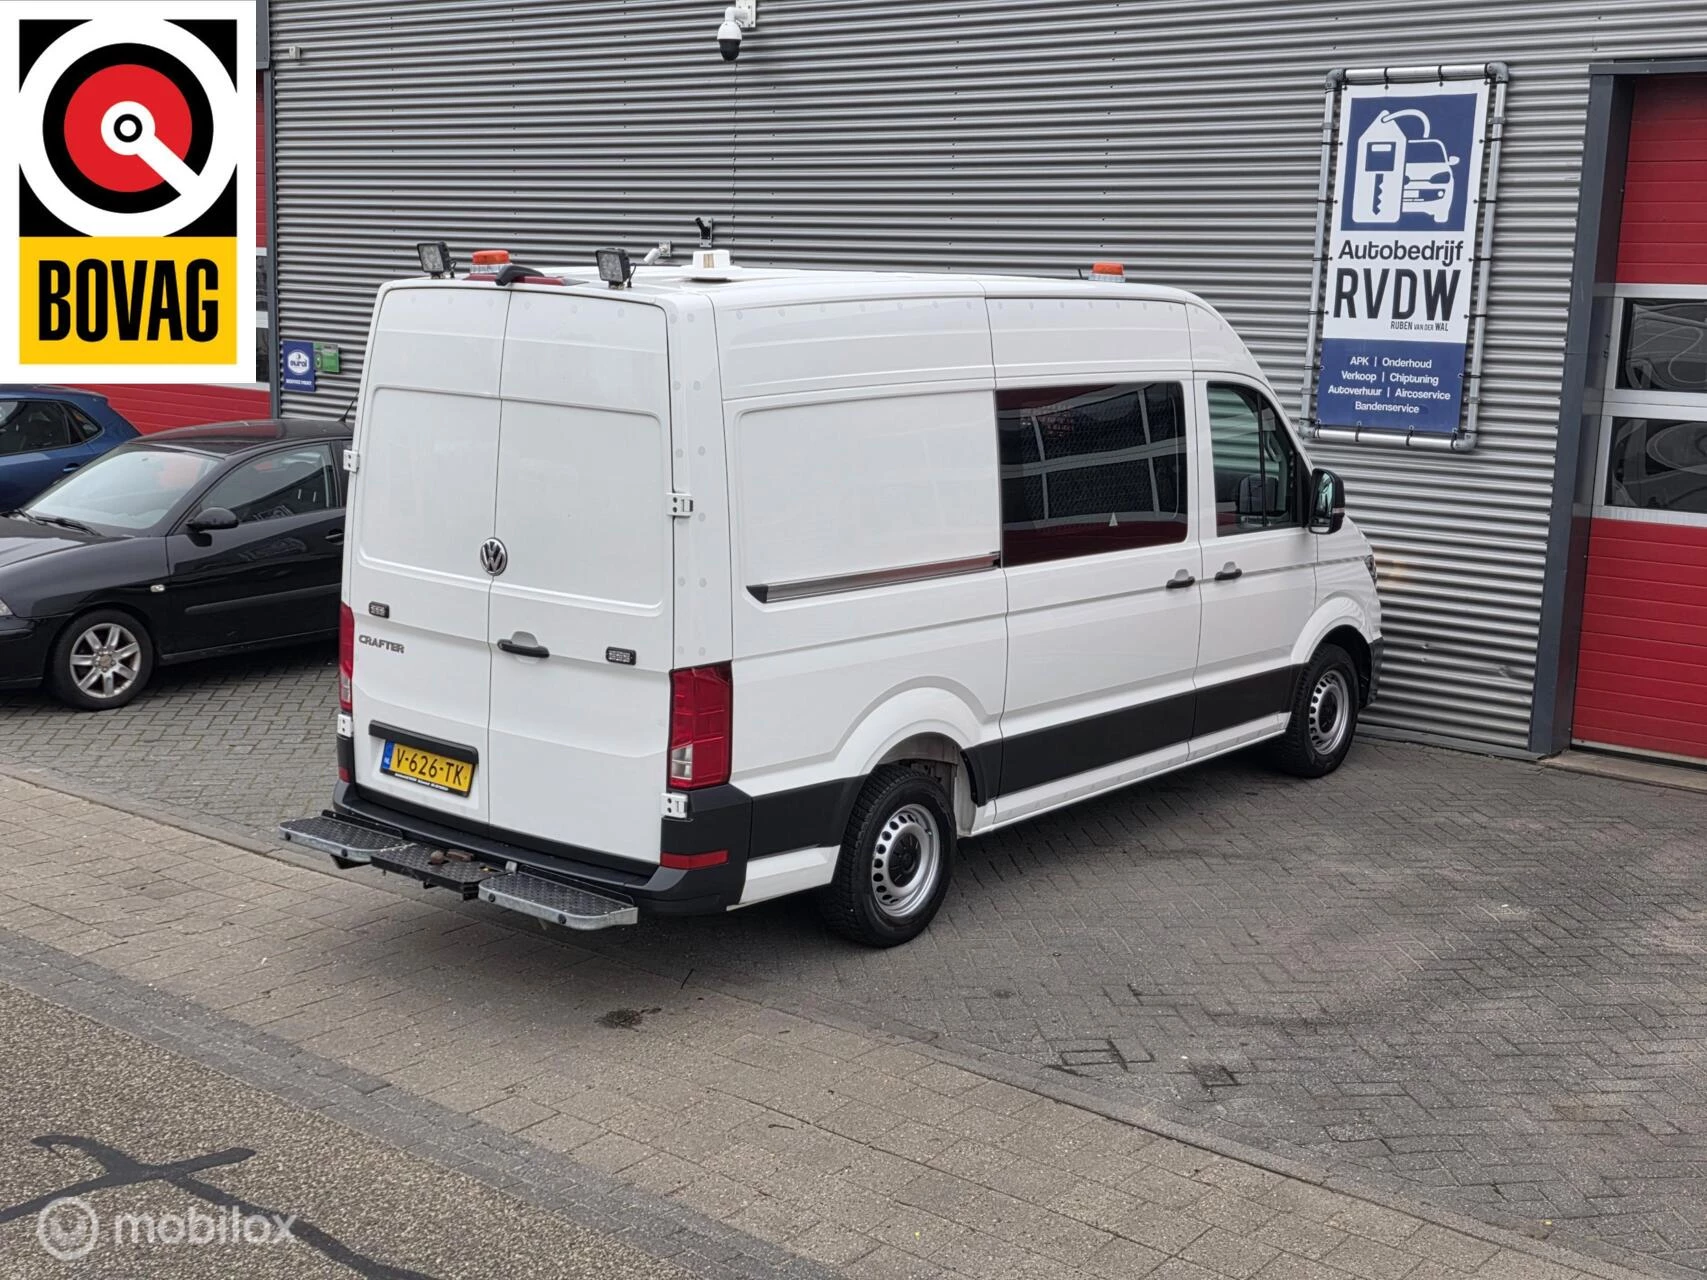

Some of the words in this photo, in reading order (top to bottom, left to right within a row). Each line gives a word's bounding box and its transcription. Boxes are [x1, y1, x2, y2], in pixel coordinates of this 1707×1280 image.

[1338, 240, 1464, 267] Autobedrijf
[1333, 267, 1462, 321] RVDW
[1390, 321, 1413, 330] RUBEN
[1434, 322, 1449, 331] WAL
[1350, 356, 1369, 366] APK
[1382, 357, 1432, 369] Onderhoud
[1341, 370, 1377, 383] Verkoop
[1389, 372, 1440, 387] Chiptuning
[1328, 384, 1383, 396] Autoverhuur
[1395, 388, 1451, 400] Aircoservice
[1355, 401, 1420, 414] Bandenservice
[358, 634, 405, 654] CRAFTER
[396, 747, 465, 786] V-626-TK
